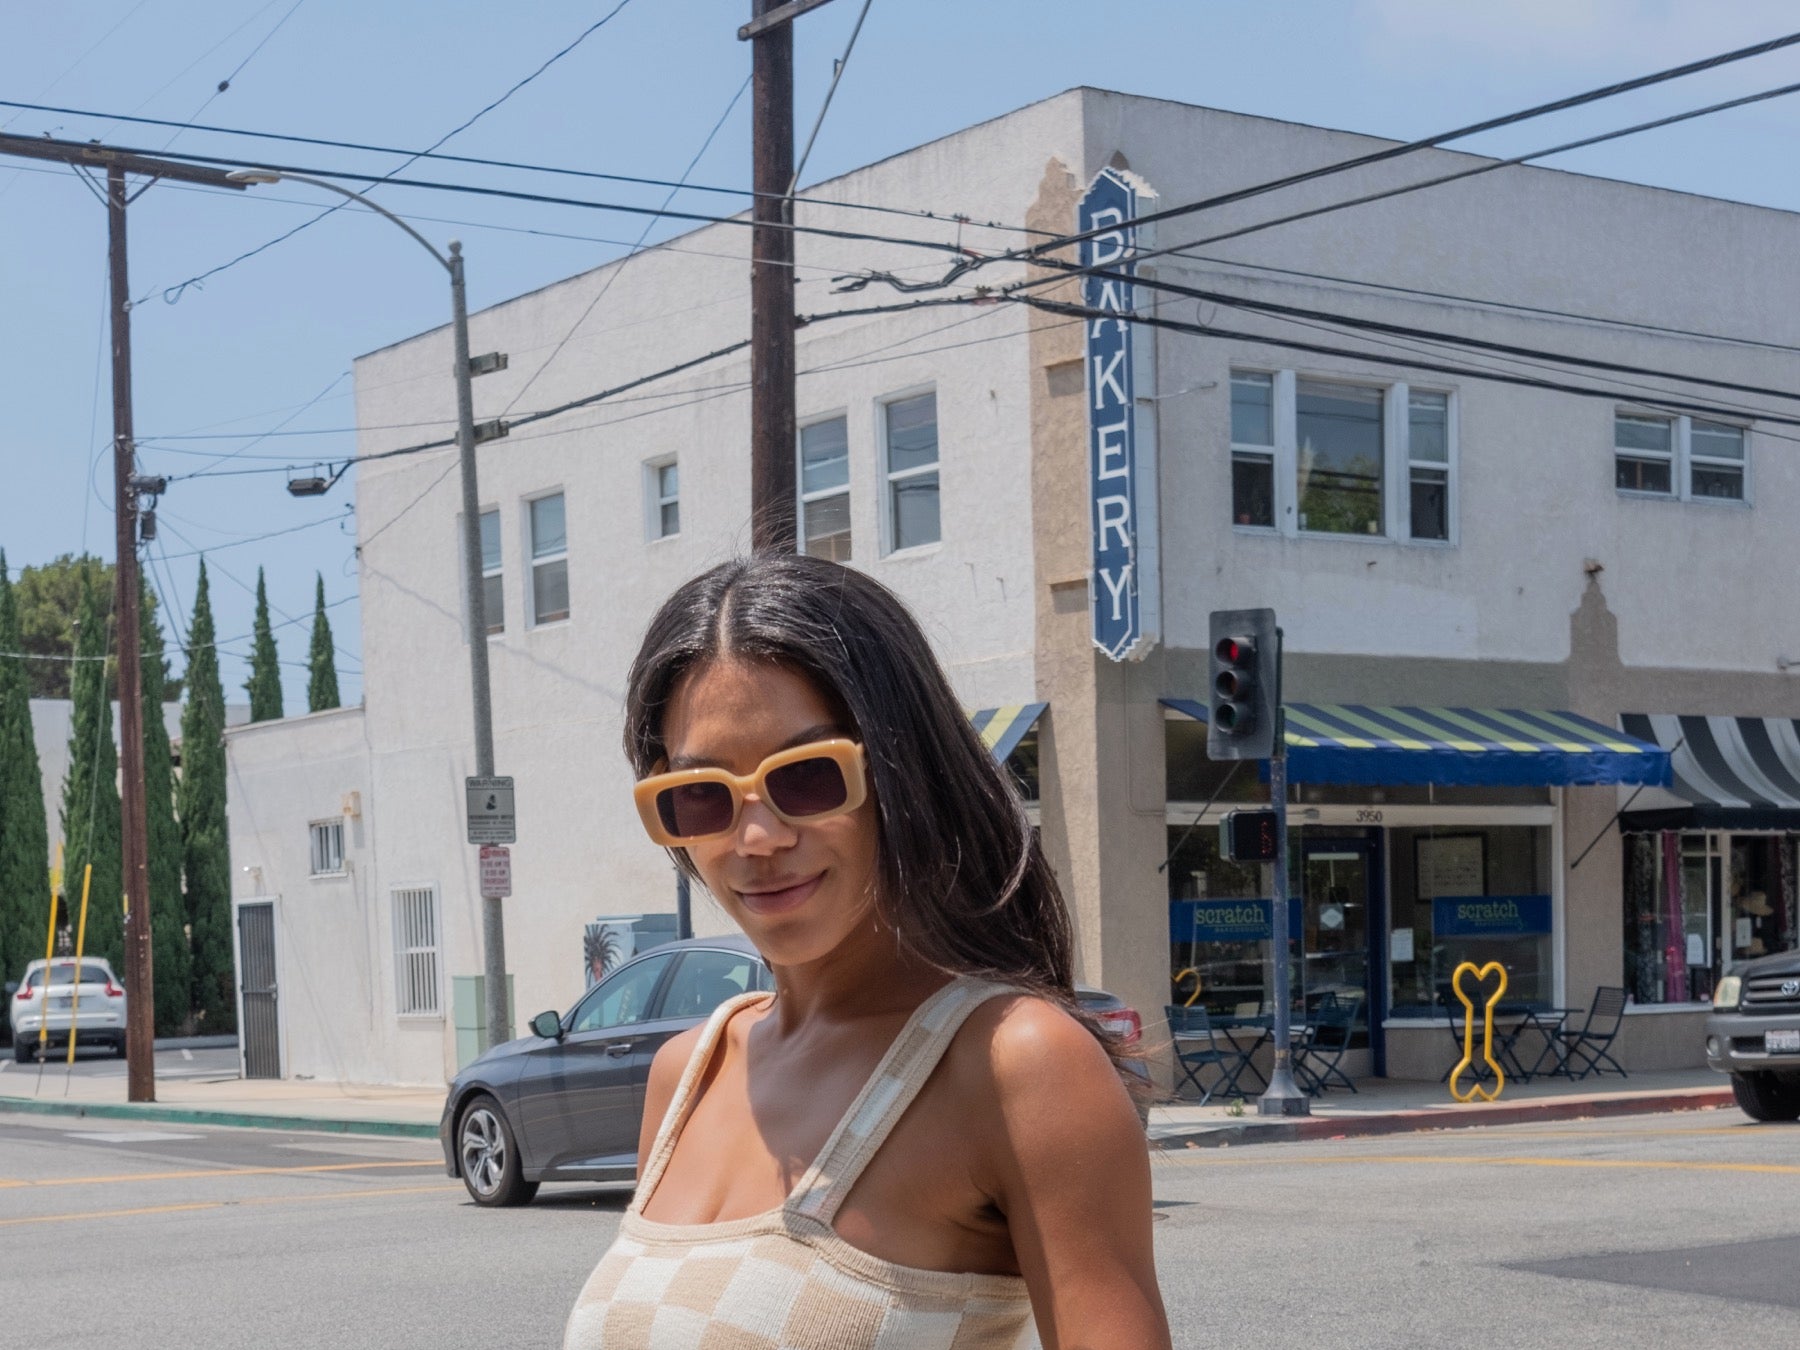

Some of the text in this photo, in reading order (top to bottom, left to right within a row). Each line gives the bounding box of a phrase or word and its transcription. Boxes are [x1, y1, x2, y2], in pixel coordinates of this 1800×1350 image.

[1090, 207, 1132, 621] BAKERY
[1355, 809, 1383, 823] 3950
[1196, 903, 1265, 924] scratch
[1457, 900, 1519, 919] scratch
